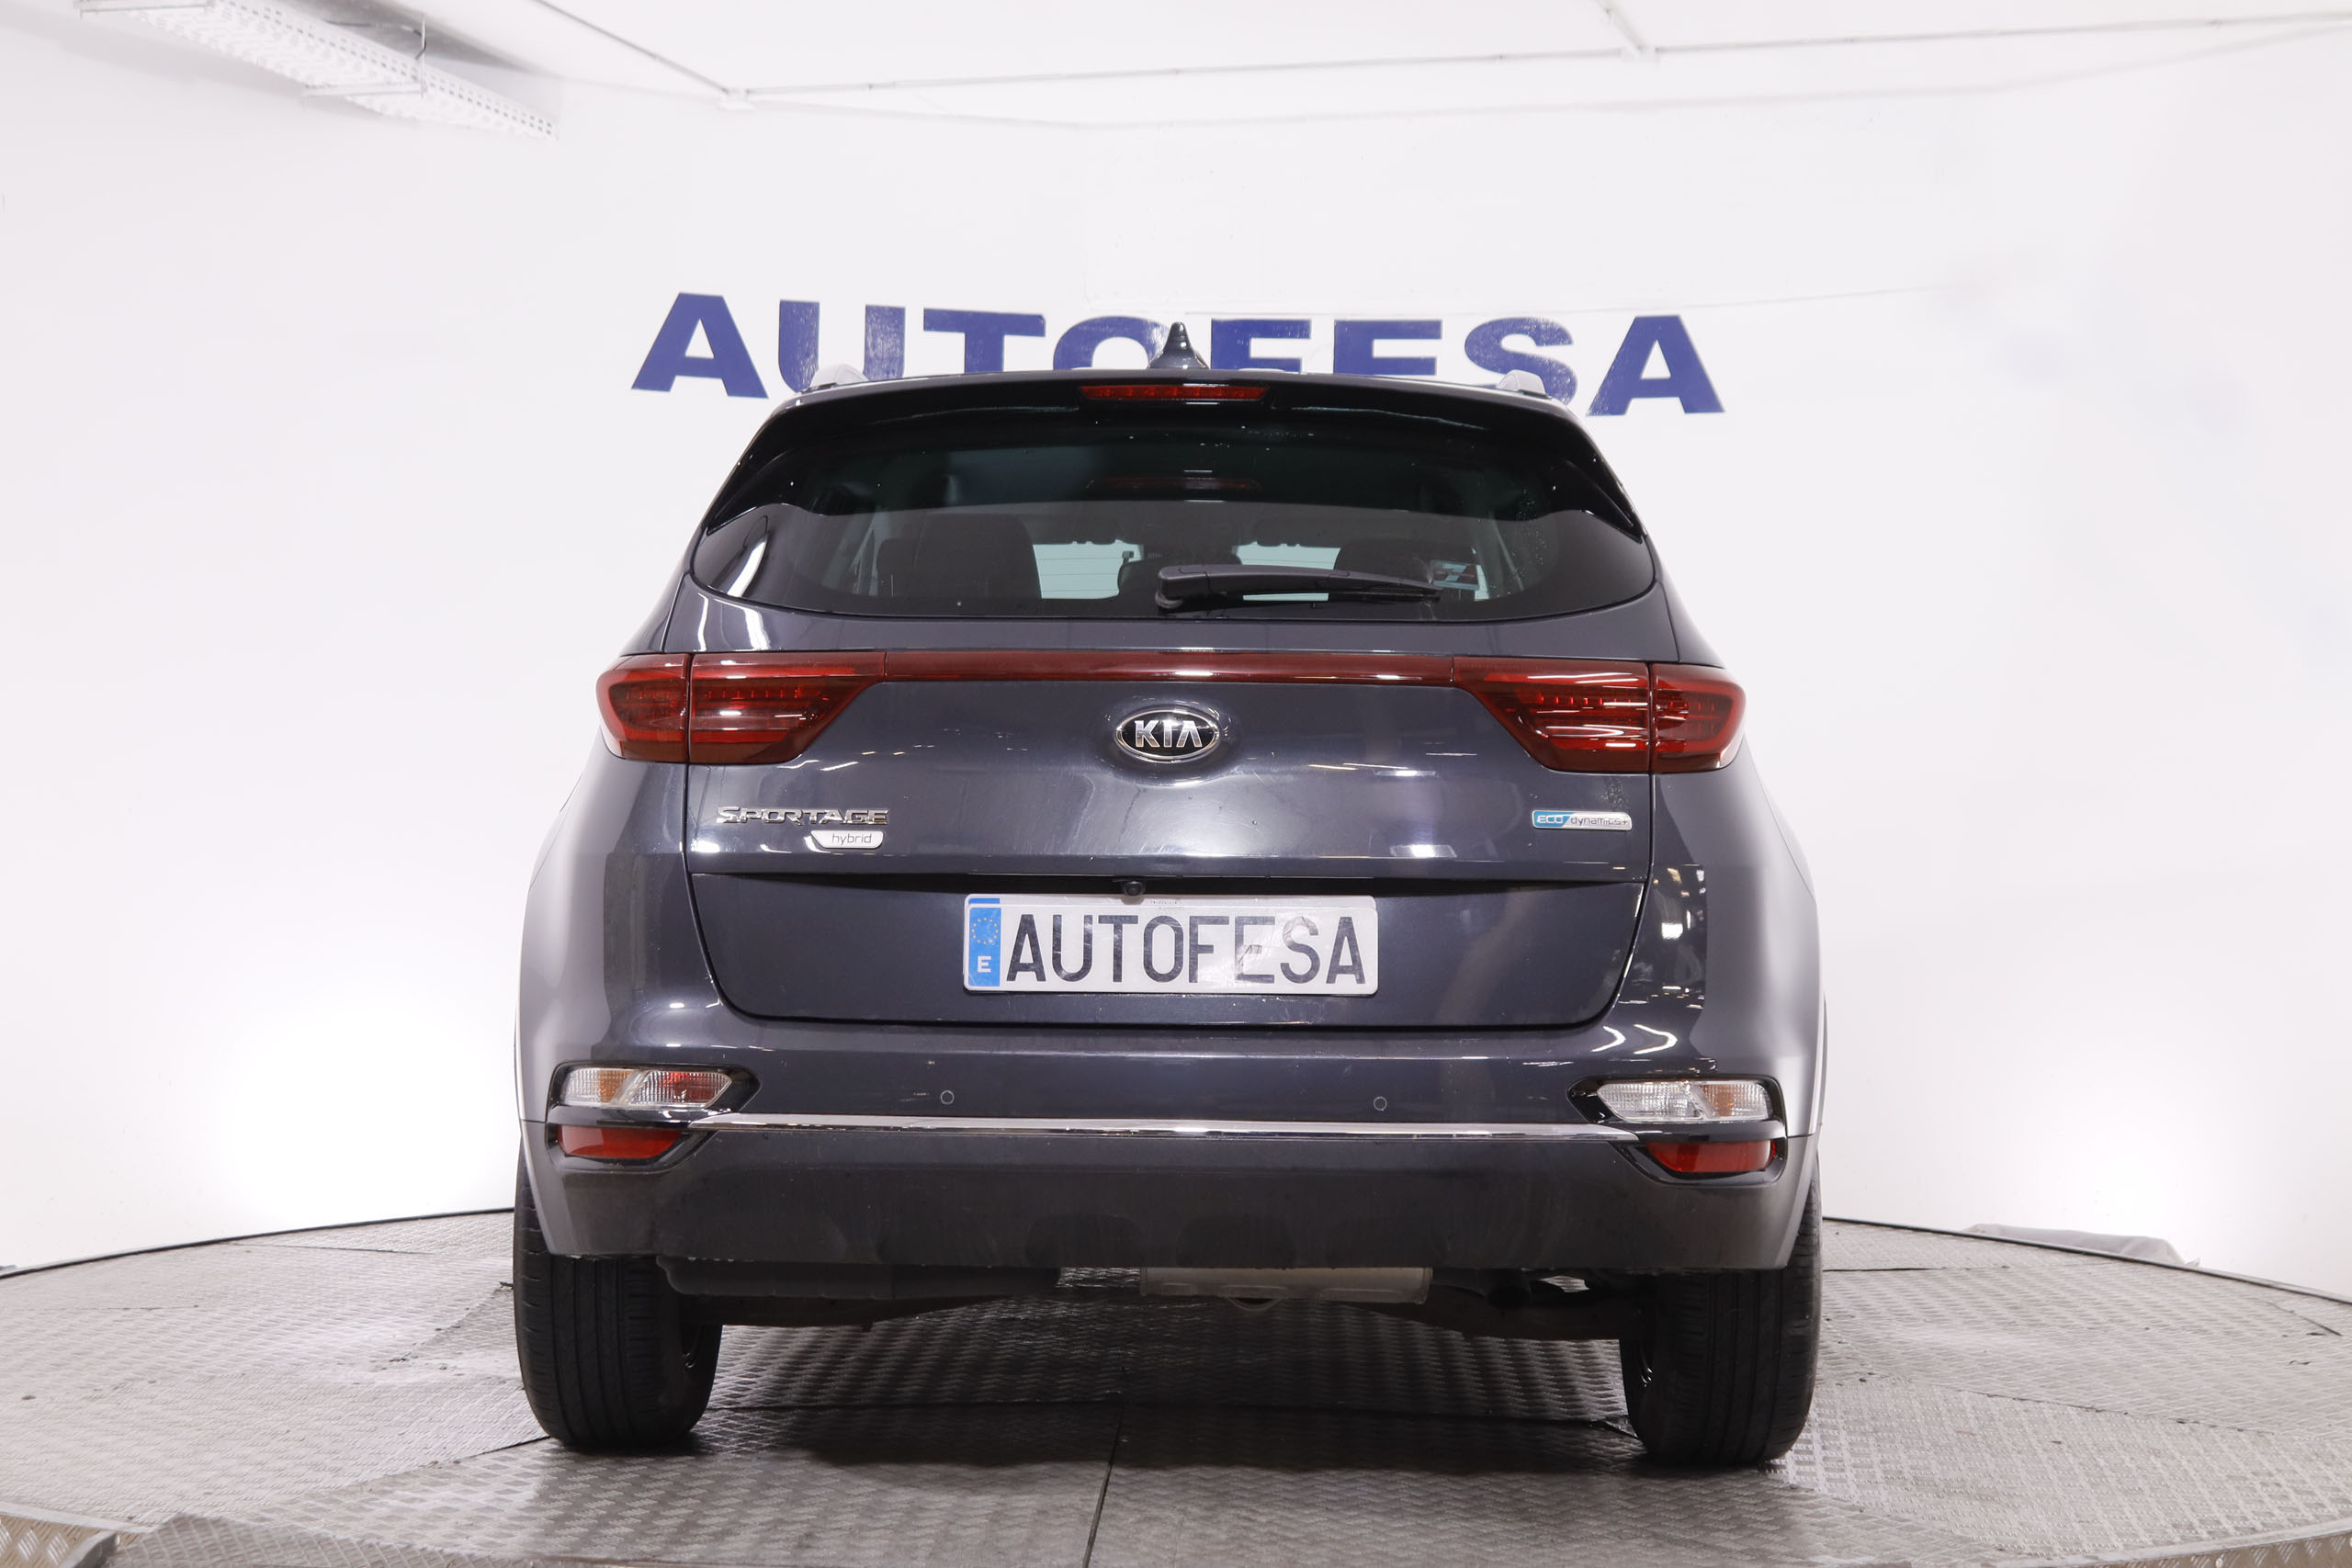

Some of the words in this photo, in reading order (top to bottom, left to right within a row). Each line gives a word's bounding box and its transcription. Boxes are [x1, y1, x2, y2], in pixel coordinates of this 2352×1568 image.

[1135, 720, 1203, 748] KIA
[717, 807, 888, 826] SPORTAGE
[831, 833, 872, 844] hybrid
[1006, 914, 1366, 985] AUTOFESA
[977, 955, 992, 973] E
